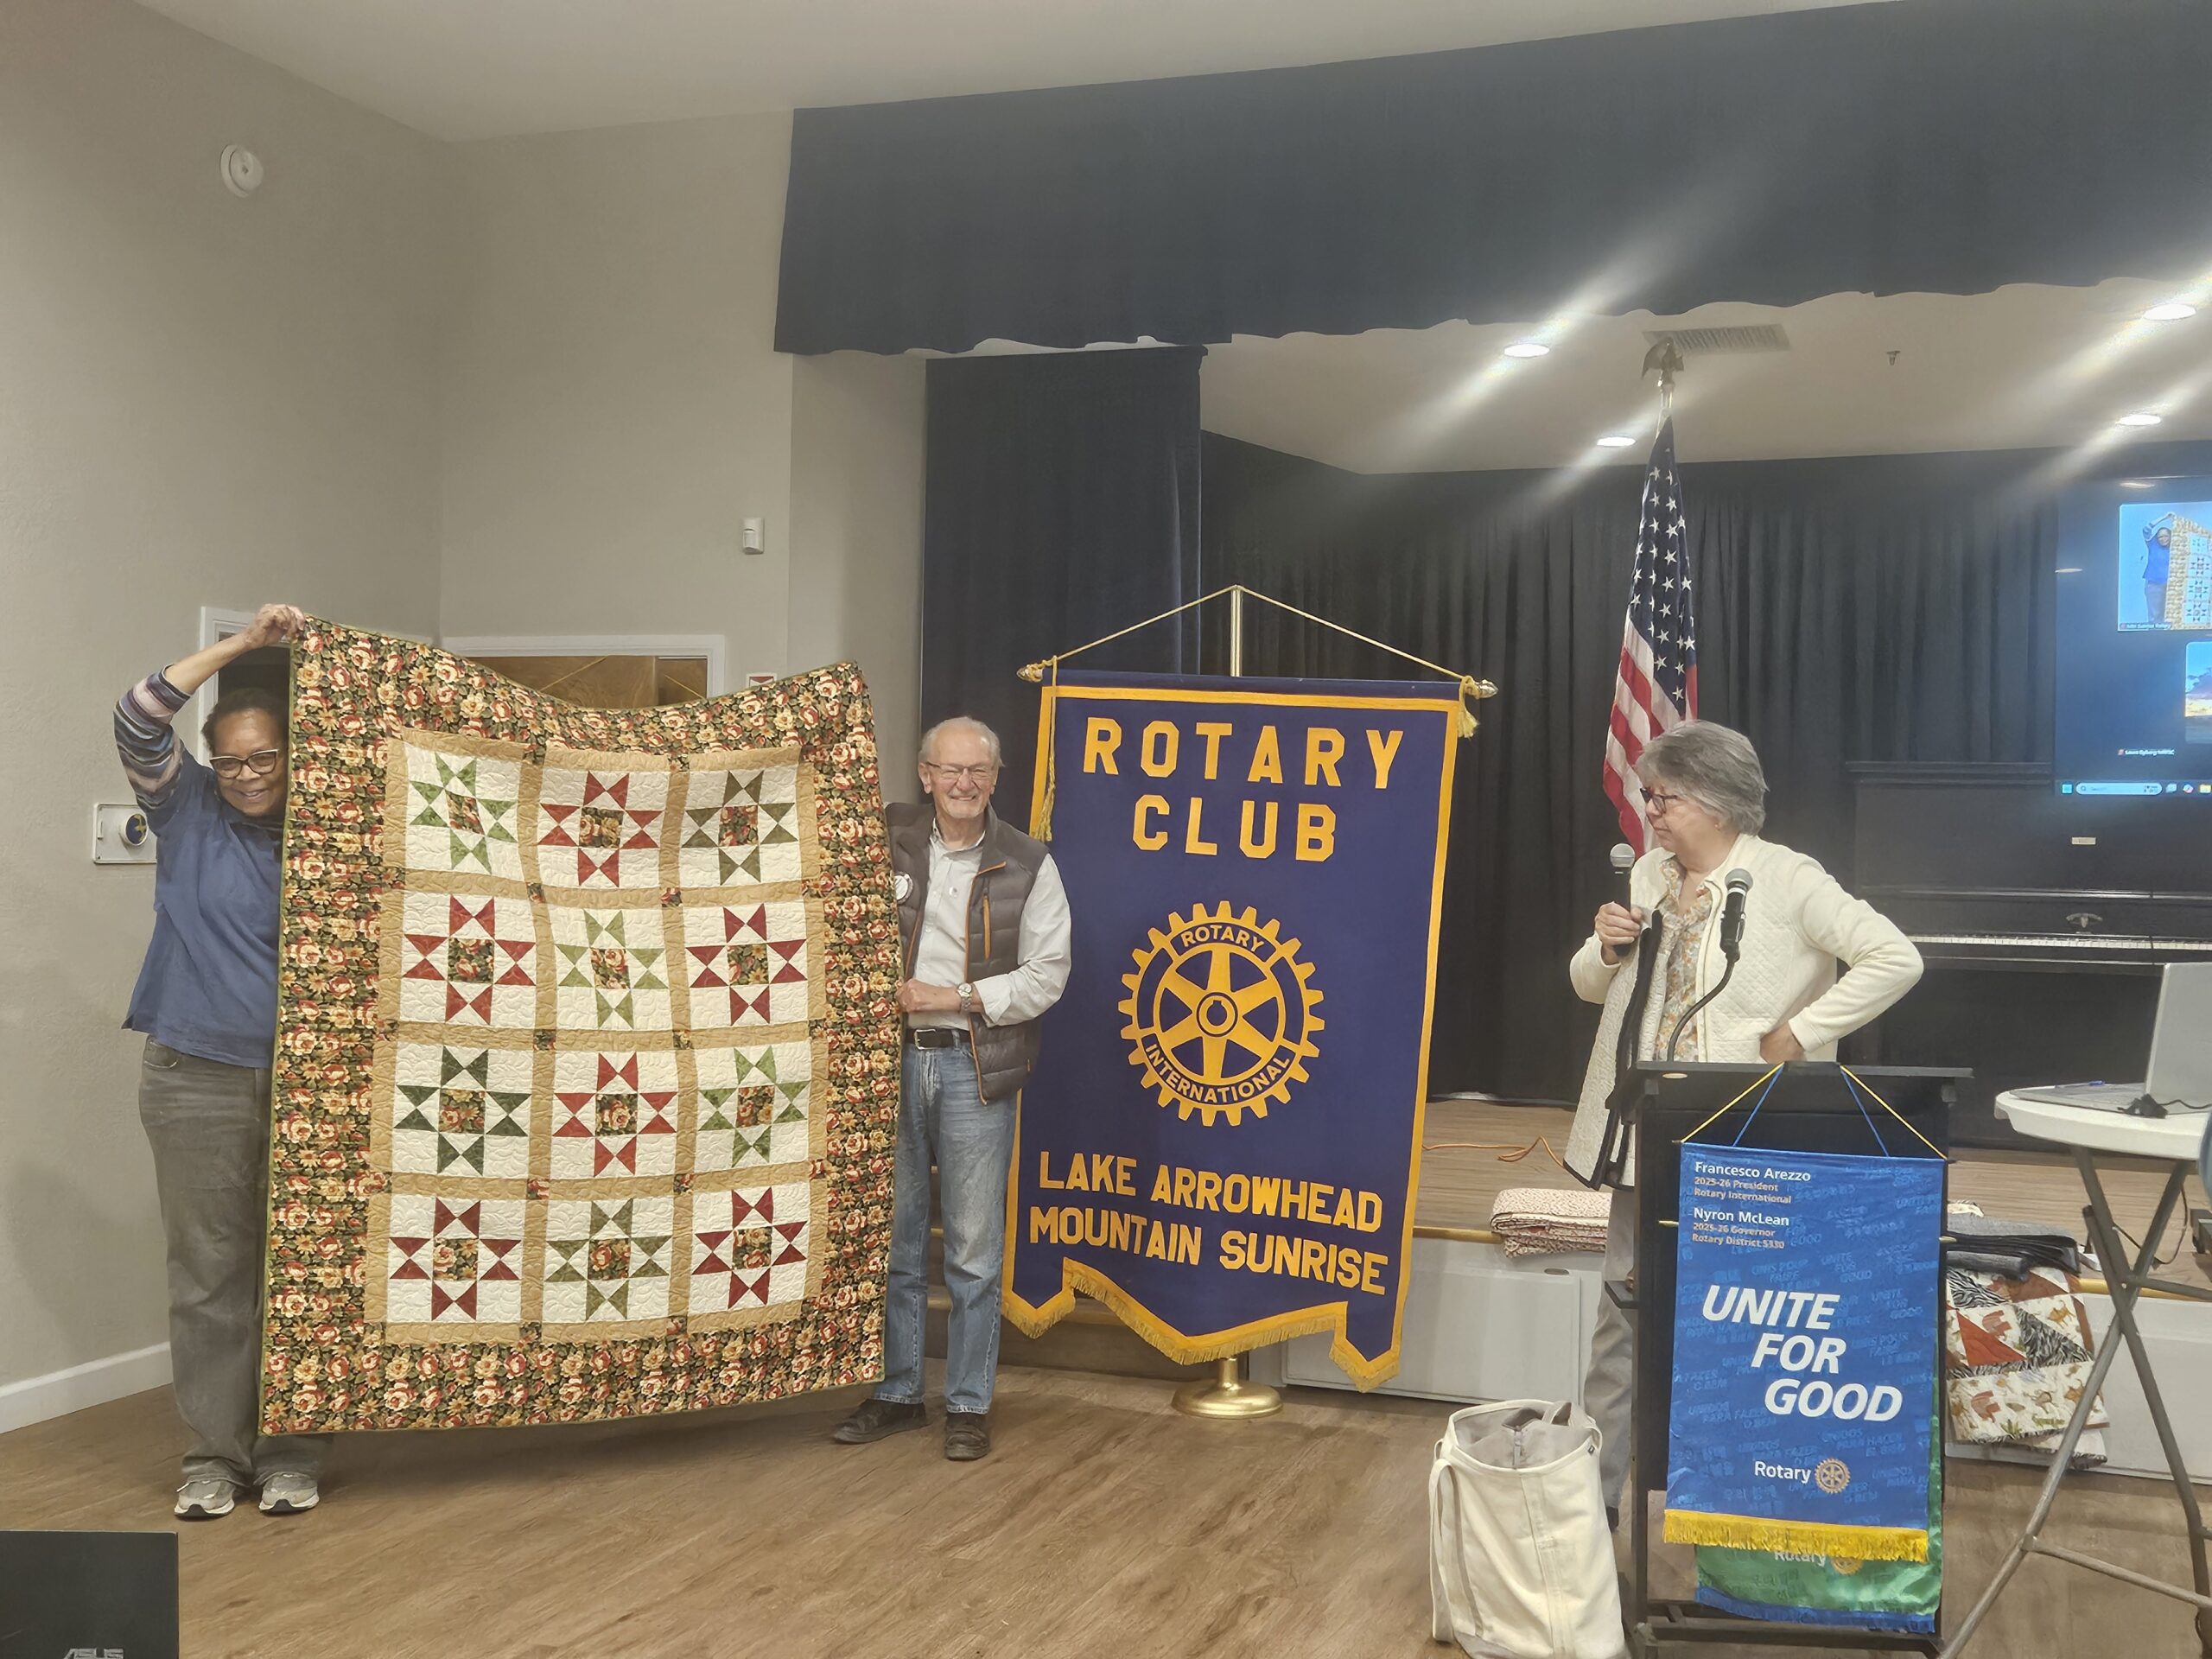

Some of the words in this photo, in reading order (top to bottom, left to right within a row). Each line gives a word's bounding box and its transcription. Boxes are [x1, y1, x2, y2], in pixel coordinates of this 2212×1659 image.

[1083, 716, 1404, 789] ROTARY
[1132, 794, 1337, 862] CLUB
[1180, 925, 1264, 952] ROTARY
[1146, 1044, 1290, 1103] INTERNATIONAL
[1694, 1177, 1731, 1187] 2025-26
[1733, 1179, 1778, 1192] President
[1695, 1161, 1760, 1178] Francesco
[1764, 1168, 1811, 1181] Arezzo
[1039, 1151, 1137, 1197] LAKE
[1150, 1164, 1383, 1233] ARROWHEAD
[1694, 1188, 1726, 1199] Rotary
[1729, 1192, 1791, 1204] International
[1693, 1223, 1729, 1232] 2025-26
[1731, 1225, 1776, 1236] Governor
[1694, 1207, 1734, 1222] Nyron
[1738, 1211, 1789, 1226] McLean
[1029, 1206, 1202, 1266] MOUNTAIN
[1219, 1230, 1389, 1295] SUNRISE
[1692, 1233, 1724, 1245] Rotary
[1726, 1236, 1761, 1247] District
[1702, 1284, 1840, 1330] UNITE
[1751, 1332, 1847, 1374] FOR
[1764, 1378, 1903, 1422] GOOD
[1753, 1460, 1812, 1484] Rotary
